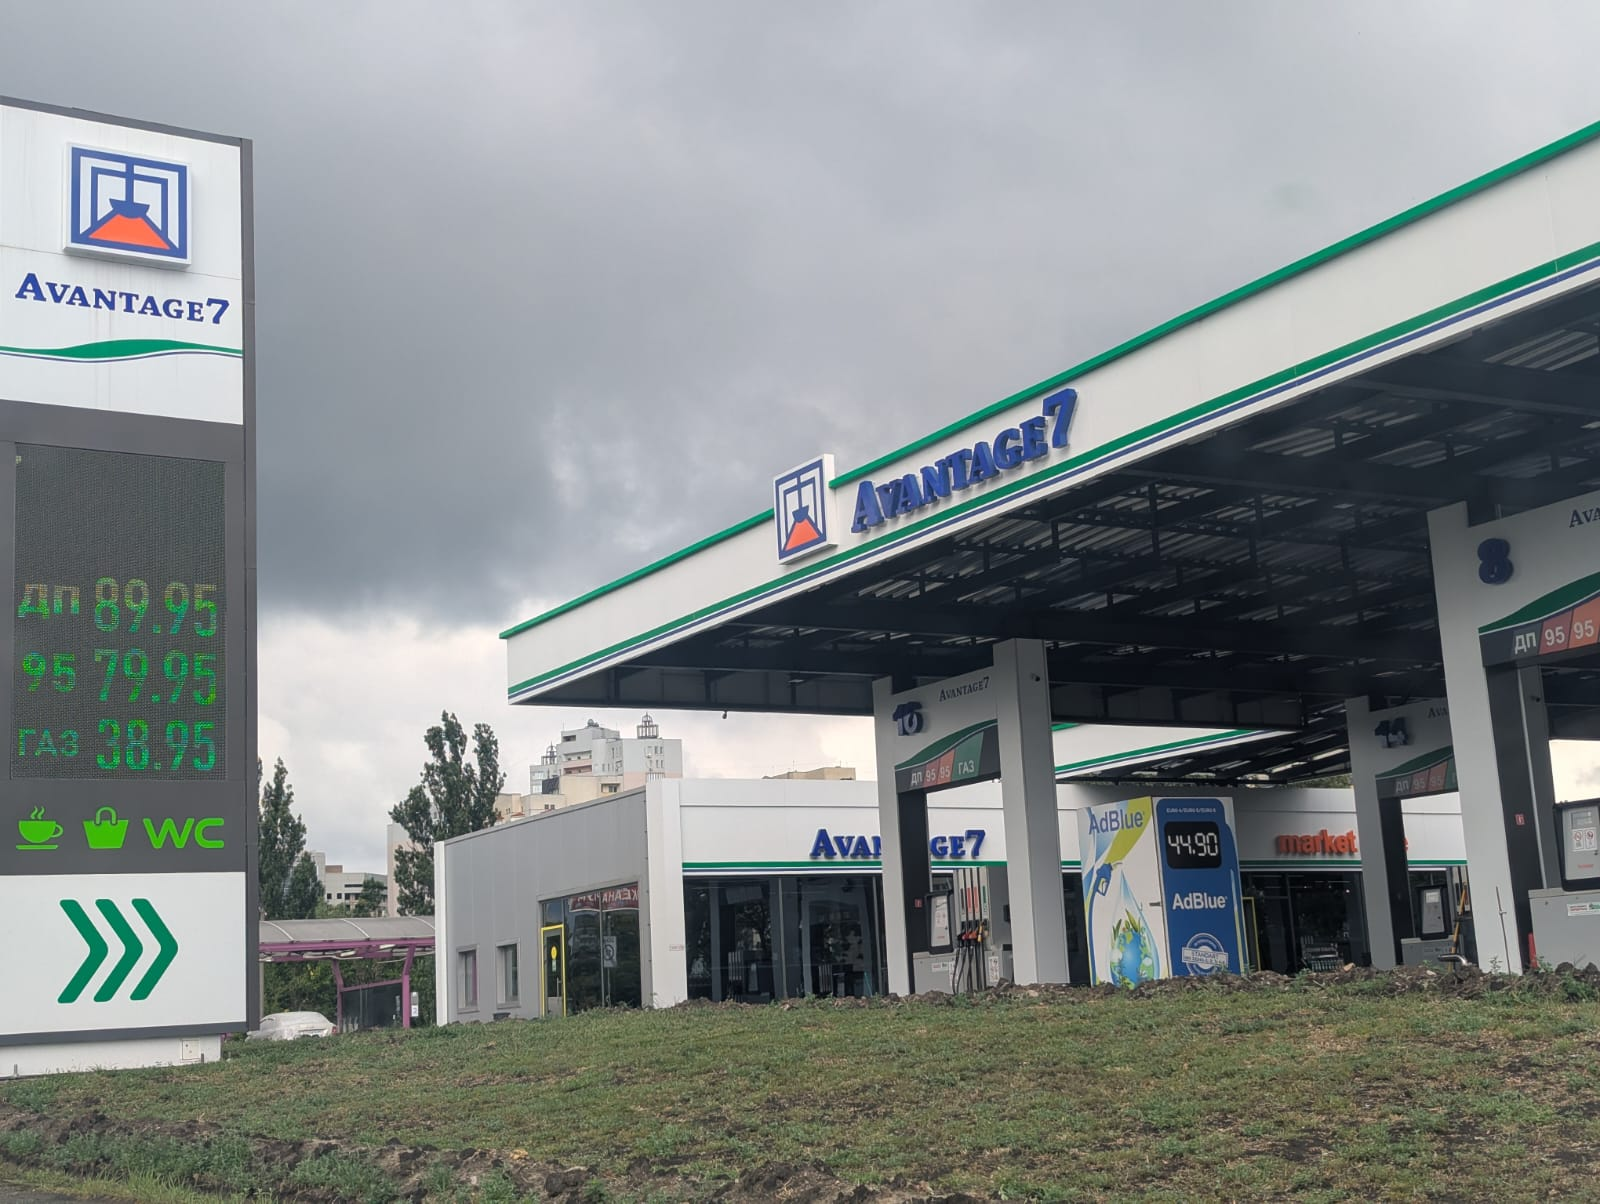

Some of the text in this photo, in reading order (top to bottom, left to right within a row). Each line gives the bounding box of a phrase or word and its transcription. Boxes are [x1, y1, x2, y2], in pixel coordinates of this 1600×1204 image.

[15, 272, 230, 325] AVANTAGE7
[850, 387, 1078, 534] AVANTAGE7
[1477, 538, 1514, 585] 8
[94, 577, 218, 638] 89.95
[1514, 619, 1594, 655] ДП 95 95
[22, 648, 217, 706] 95 79.95
[938, 676, 990, 702] AVANTAGE7
[893, 701, 924, 736] 10
[18, 718, 217, 771] ГАЗ 38.95
[911, 760, 975, 785] ДП 95 95 ГАЗ
[143, 817, 225, 849] WC
[1088, 810, 1143, 834] AdBlue
[1168, 832, 1219, 857] 44.90
[1278, 829, 1358, 855] market
[1172, 892, 1227, 910] AdBlue
